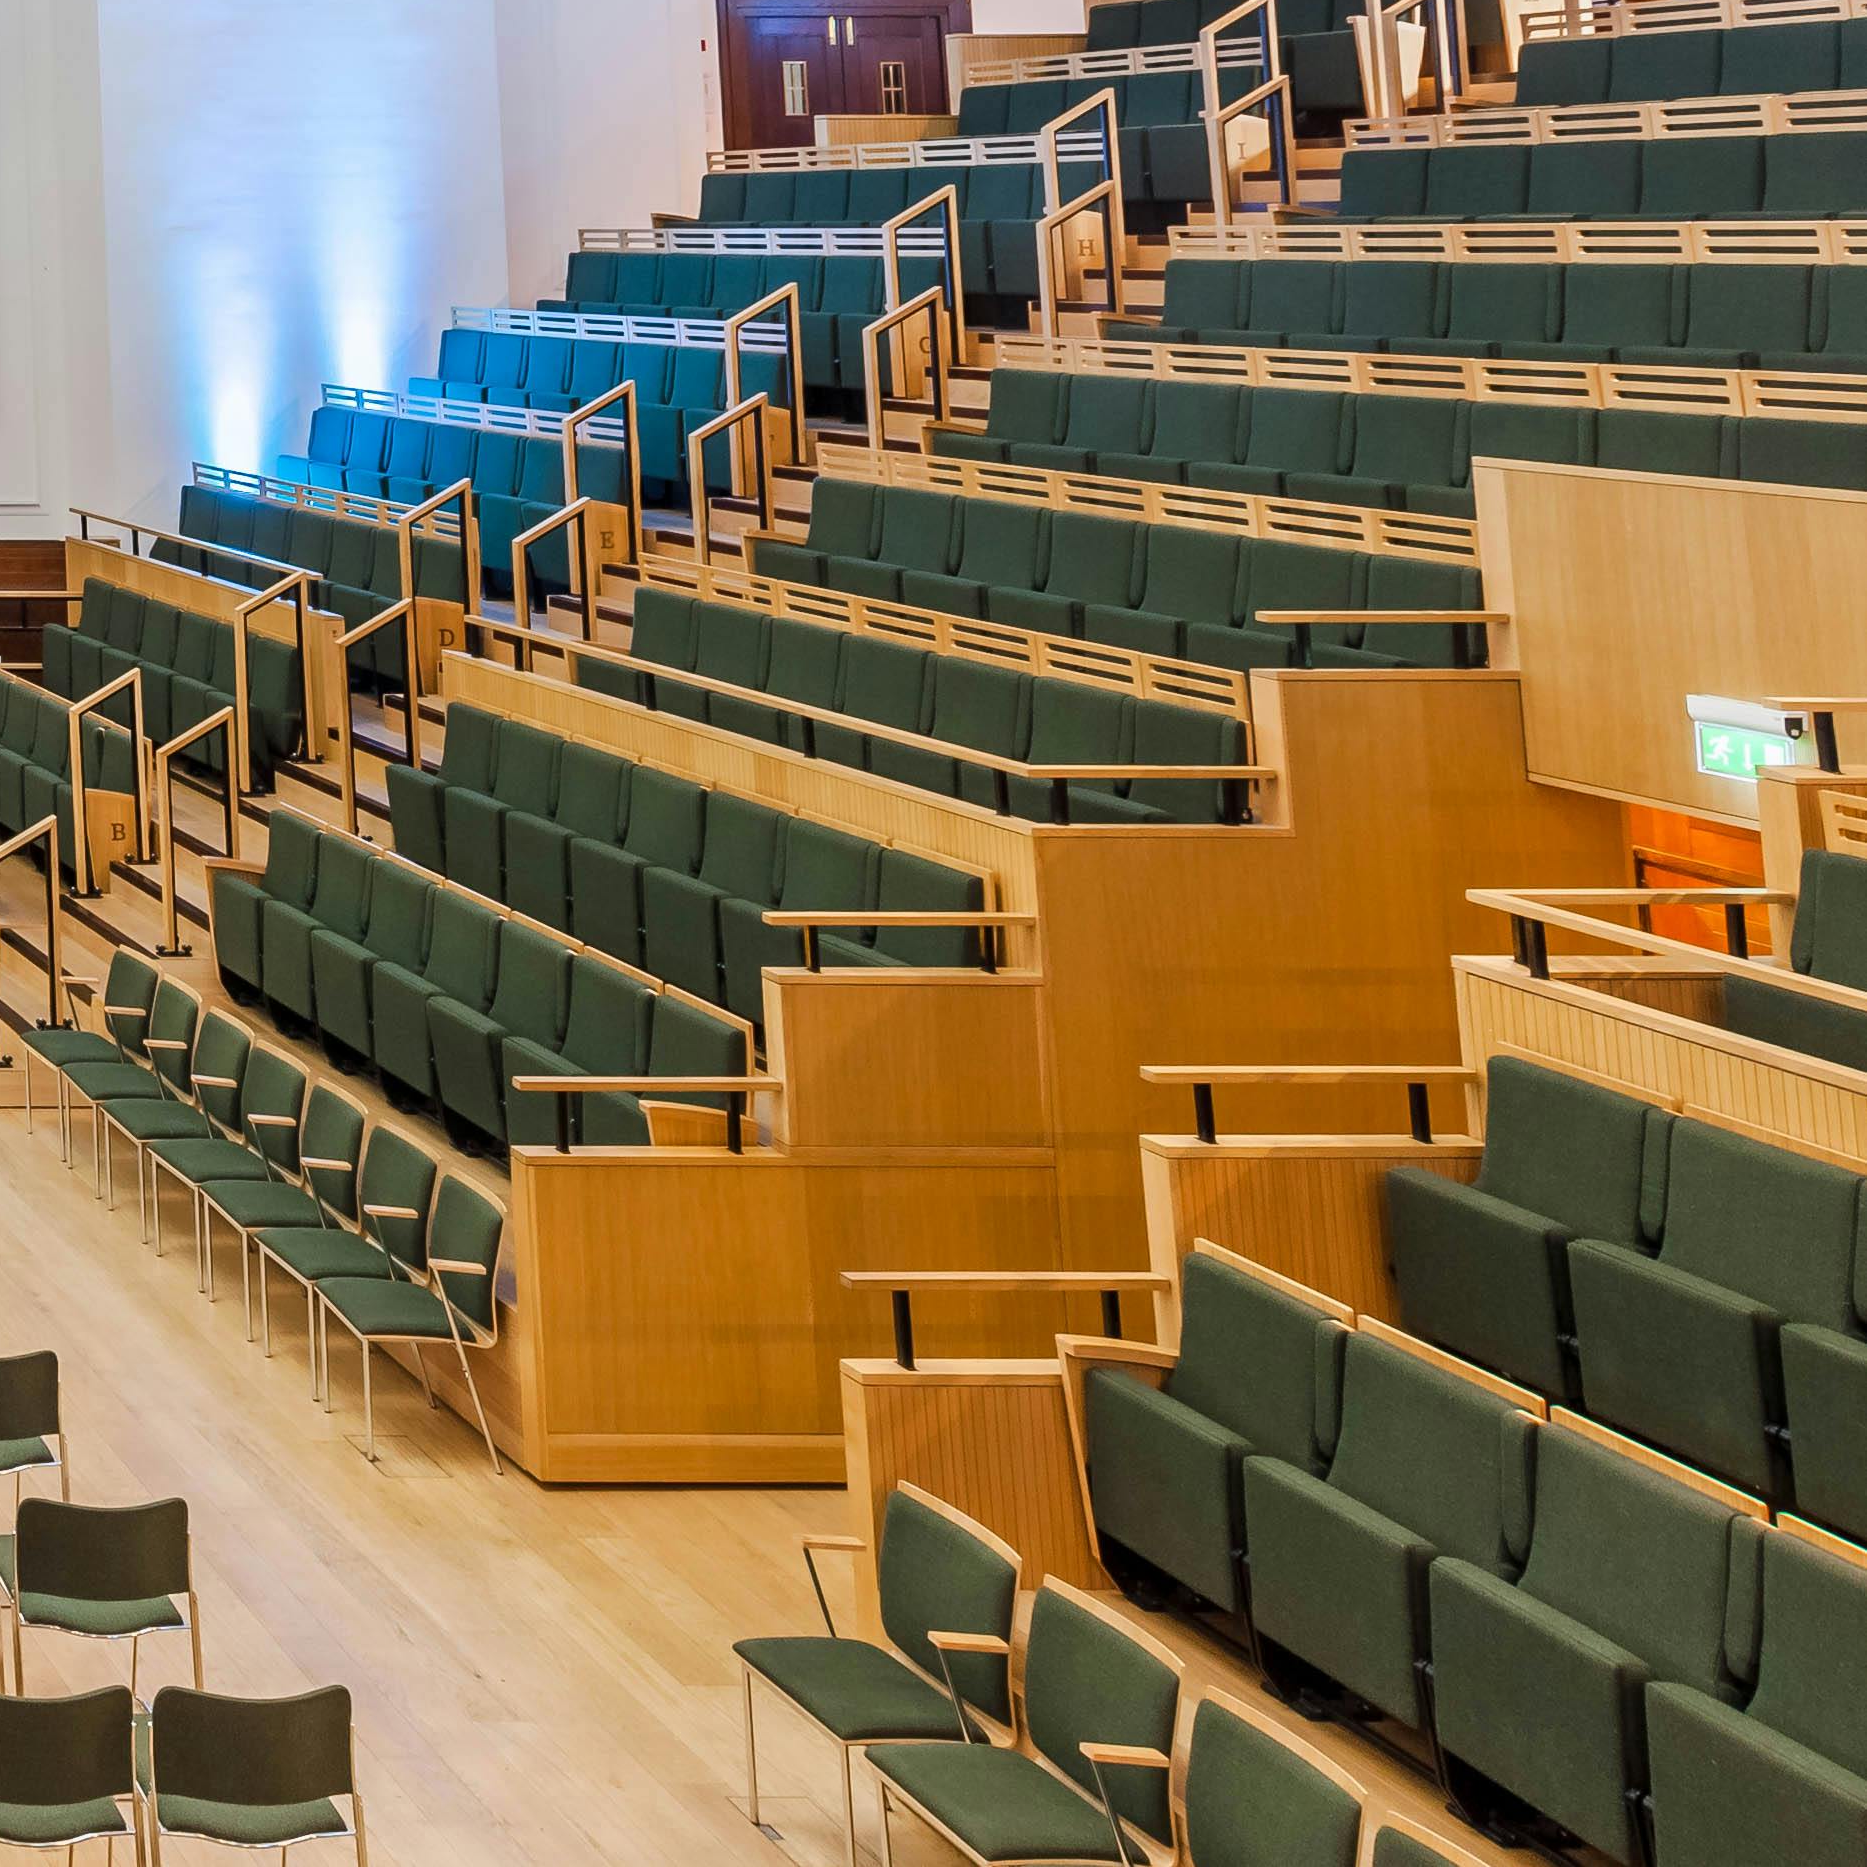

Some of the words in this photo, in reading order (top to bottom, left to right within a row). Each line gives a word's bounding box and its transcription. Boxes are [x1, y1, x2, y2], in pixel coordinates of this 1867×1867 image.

[1237, 142, 1247, 160] I
[1077, 238, 1096, 257] H
[600, 531, 615, 549] E
[438, 628, 455, 647] D
[111, 822, 126, 841] B
